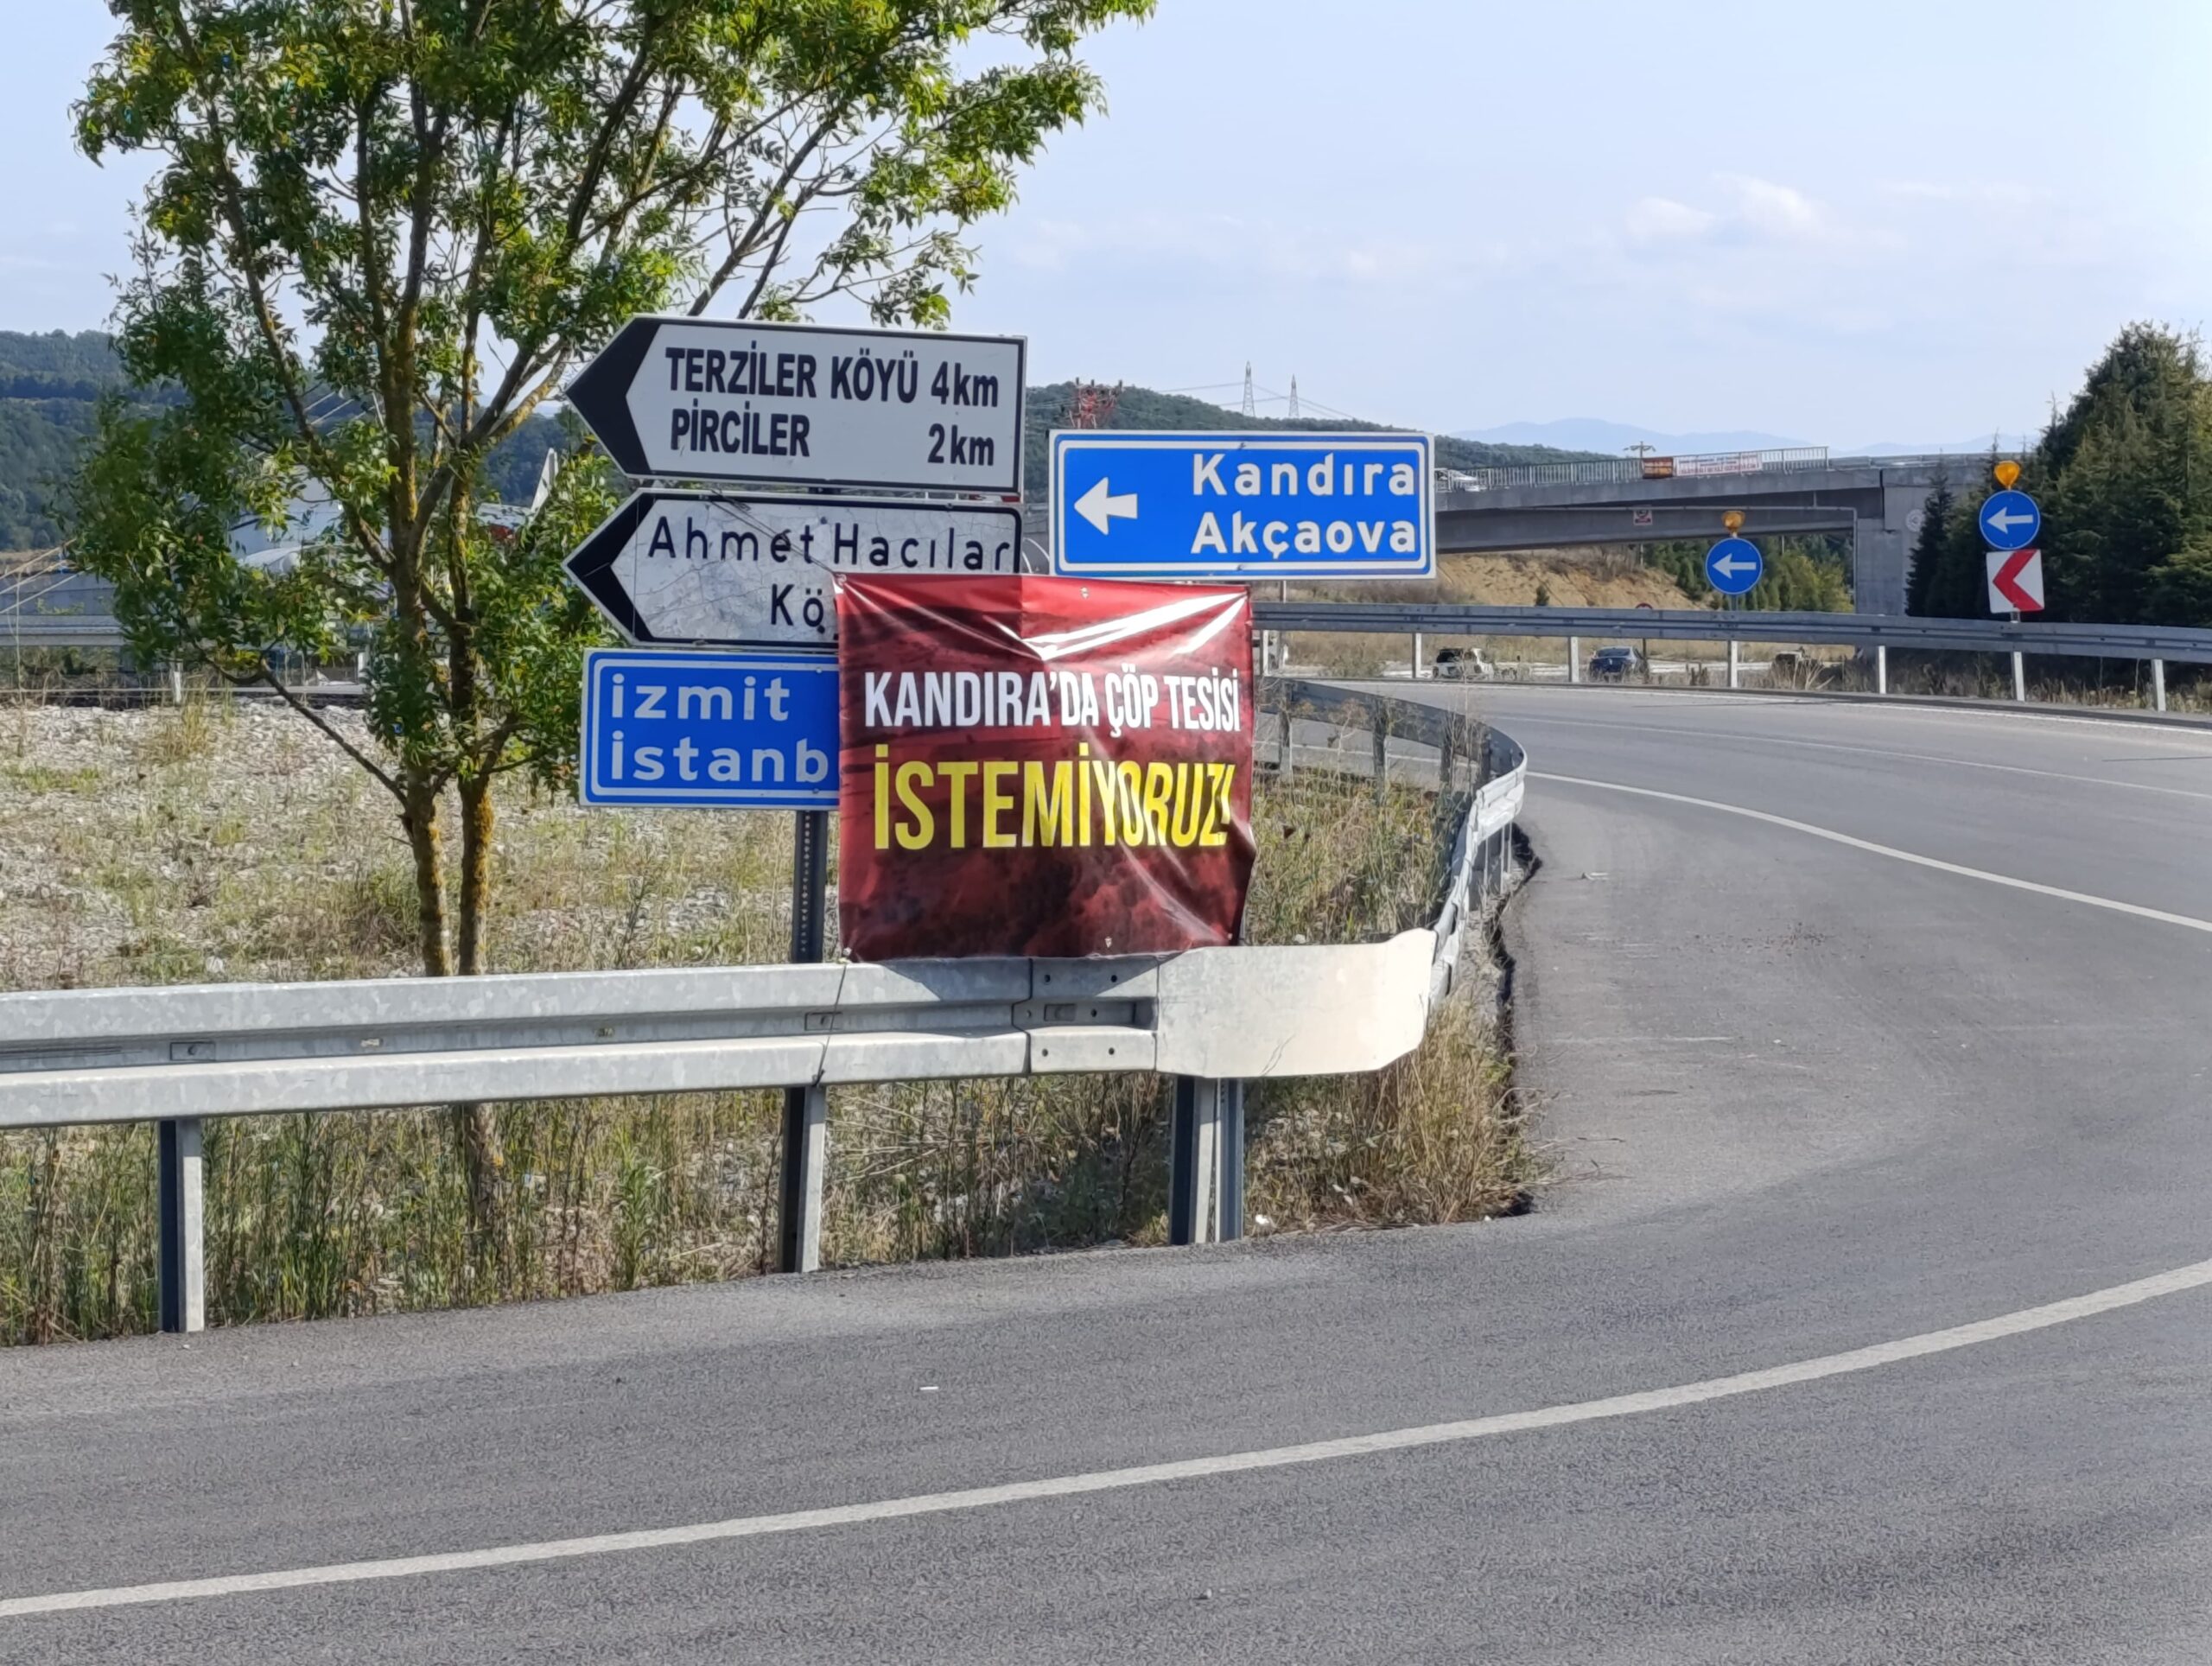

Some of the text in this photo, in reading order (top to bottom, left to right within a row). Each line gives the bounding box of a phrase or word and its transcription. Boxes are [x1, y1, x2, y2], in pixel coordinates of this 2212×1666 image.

[665, 340, 817, 398] TERZİLER
[830, 347, 918, 404] KÖYÜ
[671, 397, 810, 457] PİRCİLER
[1192, 452, 1415, 496] Kandıra
[648, 516, 1010, 570] Ahmet Hacılar
[1190, 510, 1416, 560] Akçaova
[771, 583, 836, 636] Kö
[865, 663, 1242, 738] KANDIRA'DA ÇÖP TESİSİ
[874, 742, 1236, 850] İSTEMİYORUZ!
